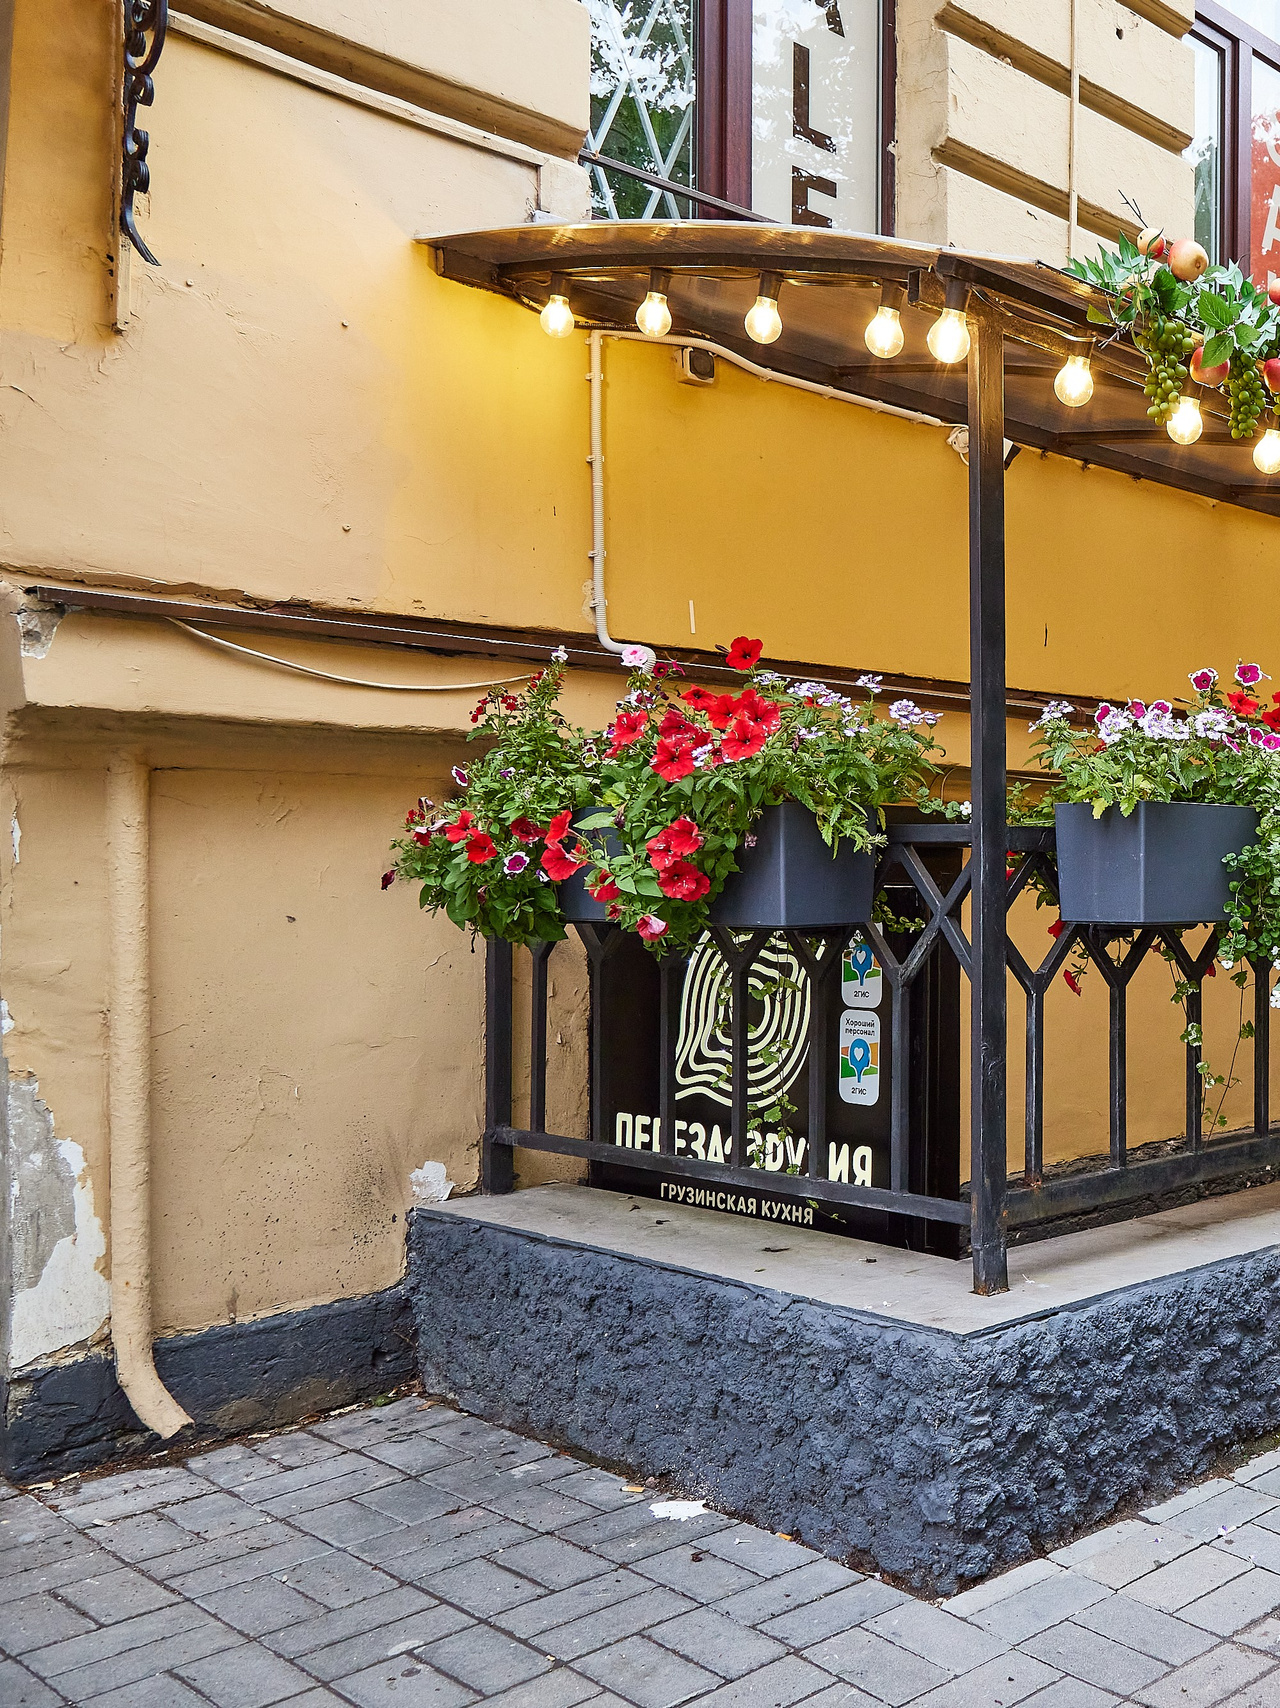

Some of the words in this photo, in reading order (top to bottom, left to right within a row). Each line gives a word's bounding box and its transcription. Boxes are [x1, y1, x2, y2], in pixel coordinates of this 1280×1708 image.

[853, 990, 870, 998] 2ГИС
[845, 1017, 875, 1029] Хороший
[844, 1027, 875, 1037] персонал
[851, 1087, 867, 1095] 2ГИС
[660, 1182, 757, 1215] ГРУЗИНСКАЯ
[761, 1200, 814, 1225] КУХНЯ
